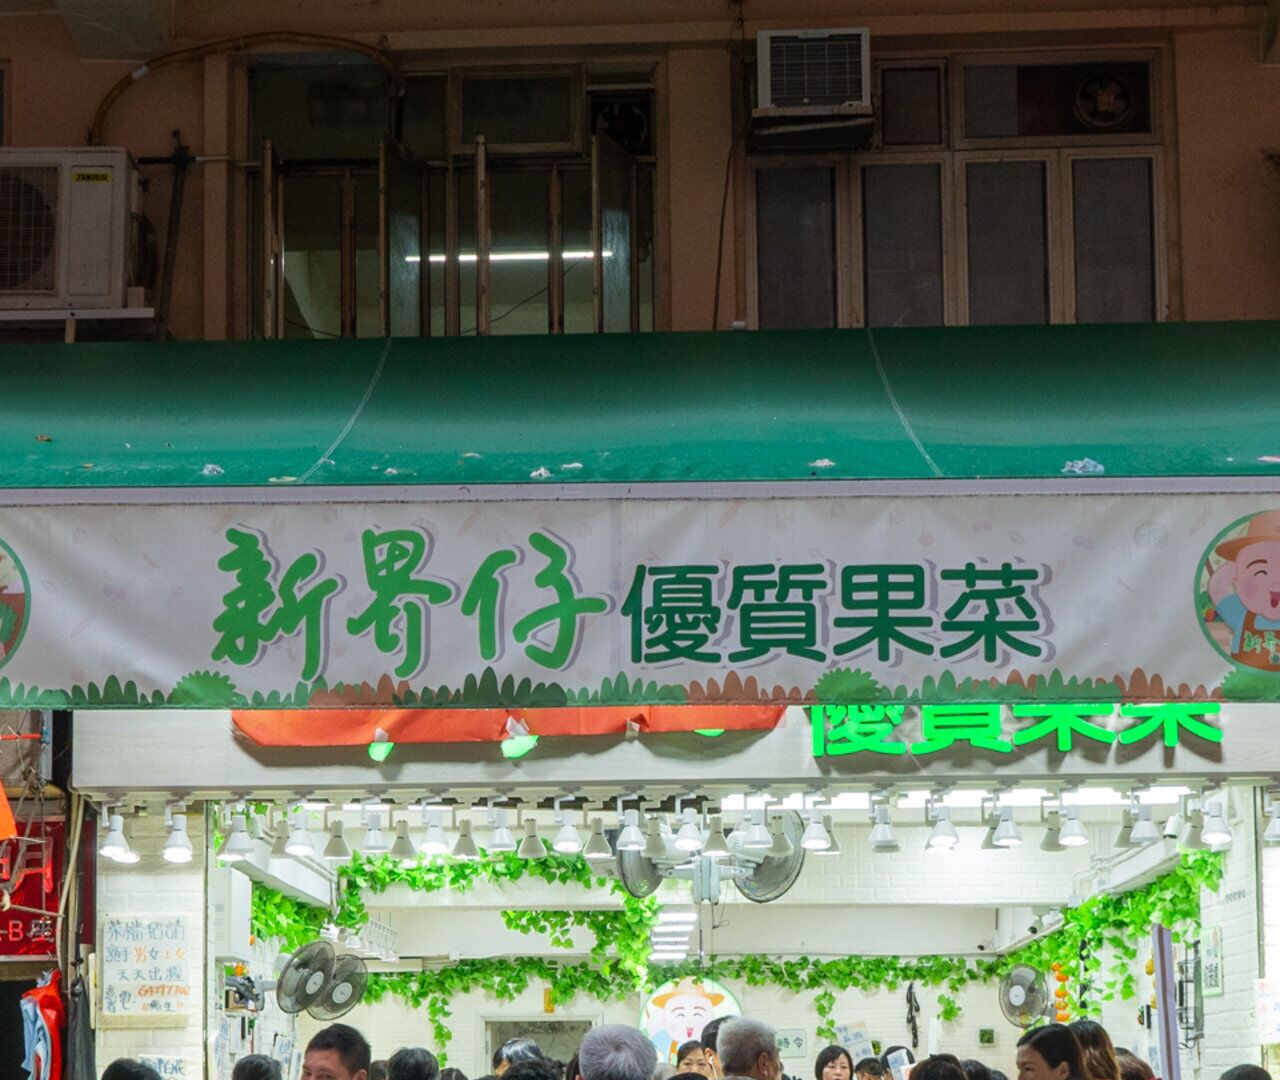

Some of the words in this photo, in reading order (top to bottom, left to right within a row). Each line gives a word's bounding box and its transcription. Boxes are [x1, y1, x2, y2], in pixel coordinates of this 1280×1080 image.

[211, 527, 608, 682] 新界仔
[622, 562, 1042, 664] 優質果菜
